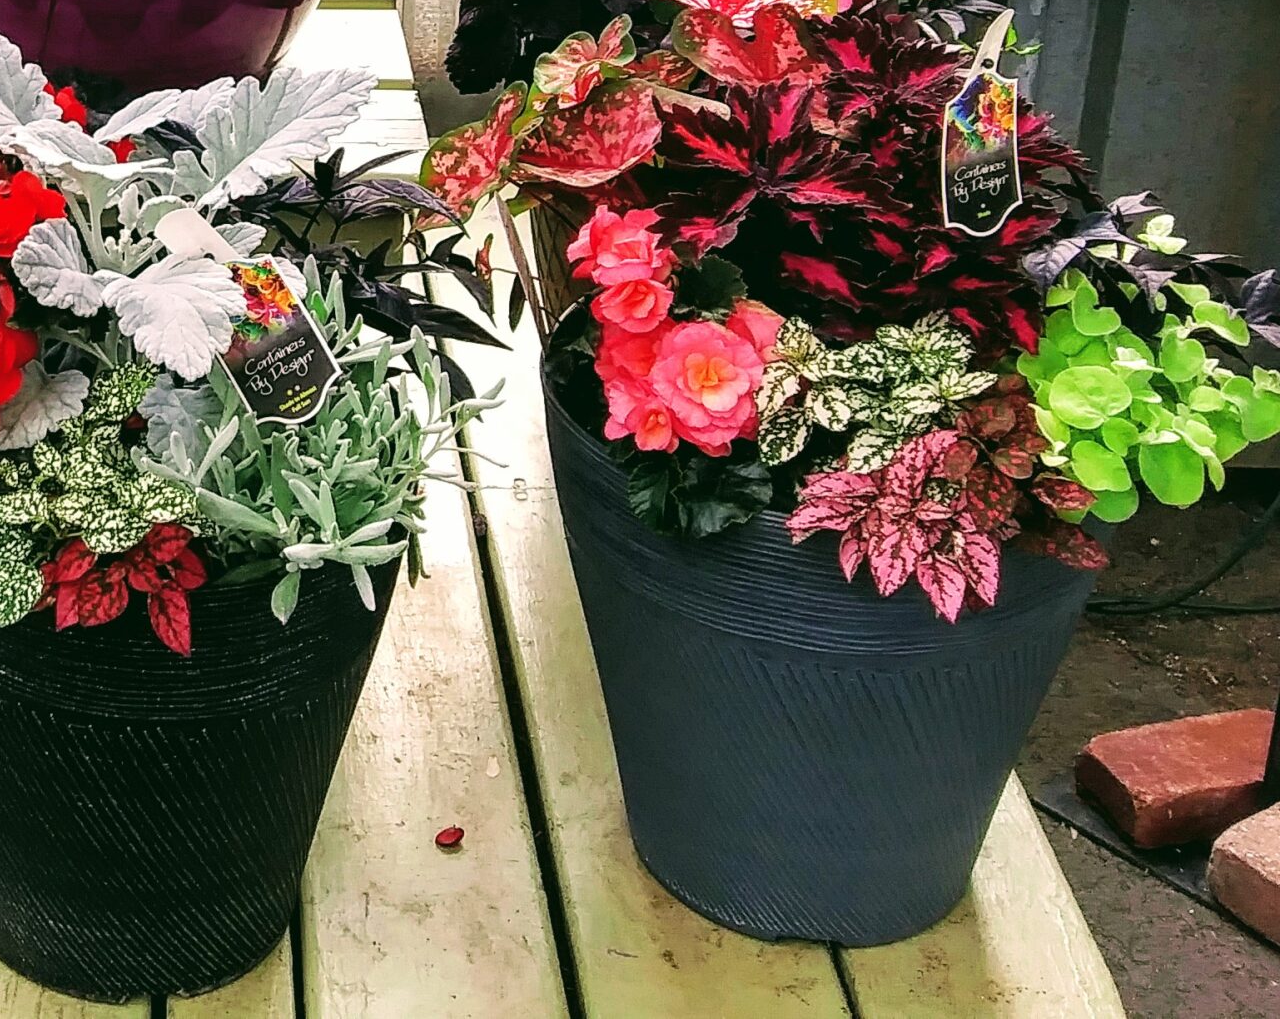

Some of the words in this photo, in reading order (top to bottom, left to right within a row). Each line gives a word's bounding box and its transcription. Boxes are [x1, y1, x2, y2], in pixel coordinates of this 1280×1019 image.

[954, 160, 1007, 182] Containers
[950, 181, 970, 204] By
[244, 336, 306, 375] Containers
[245, 374, 274, 396] By
